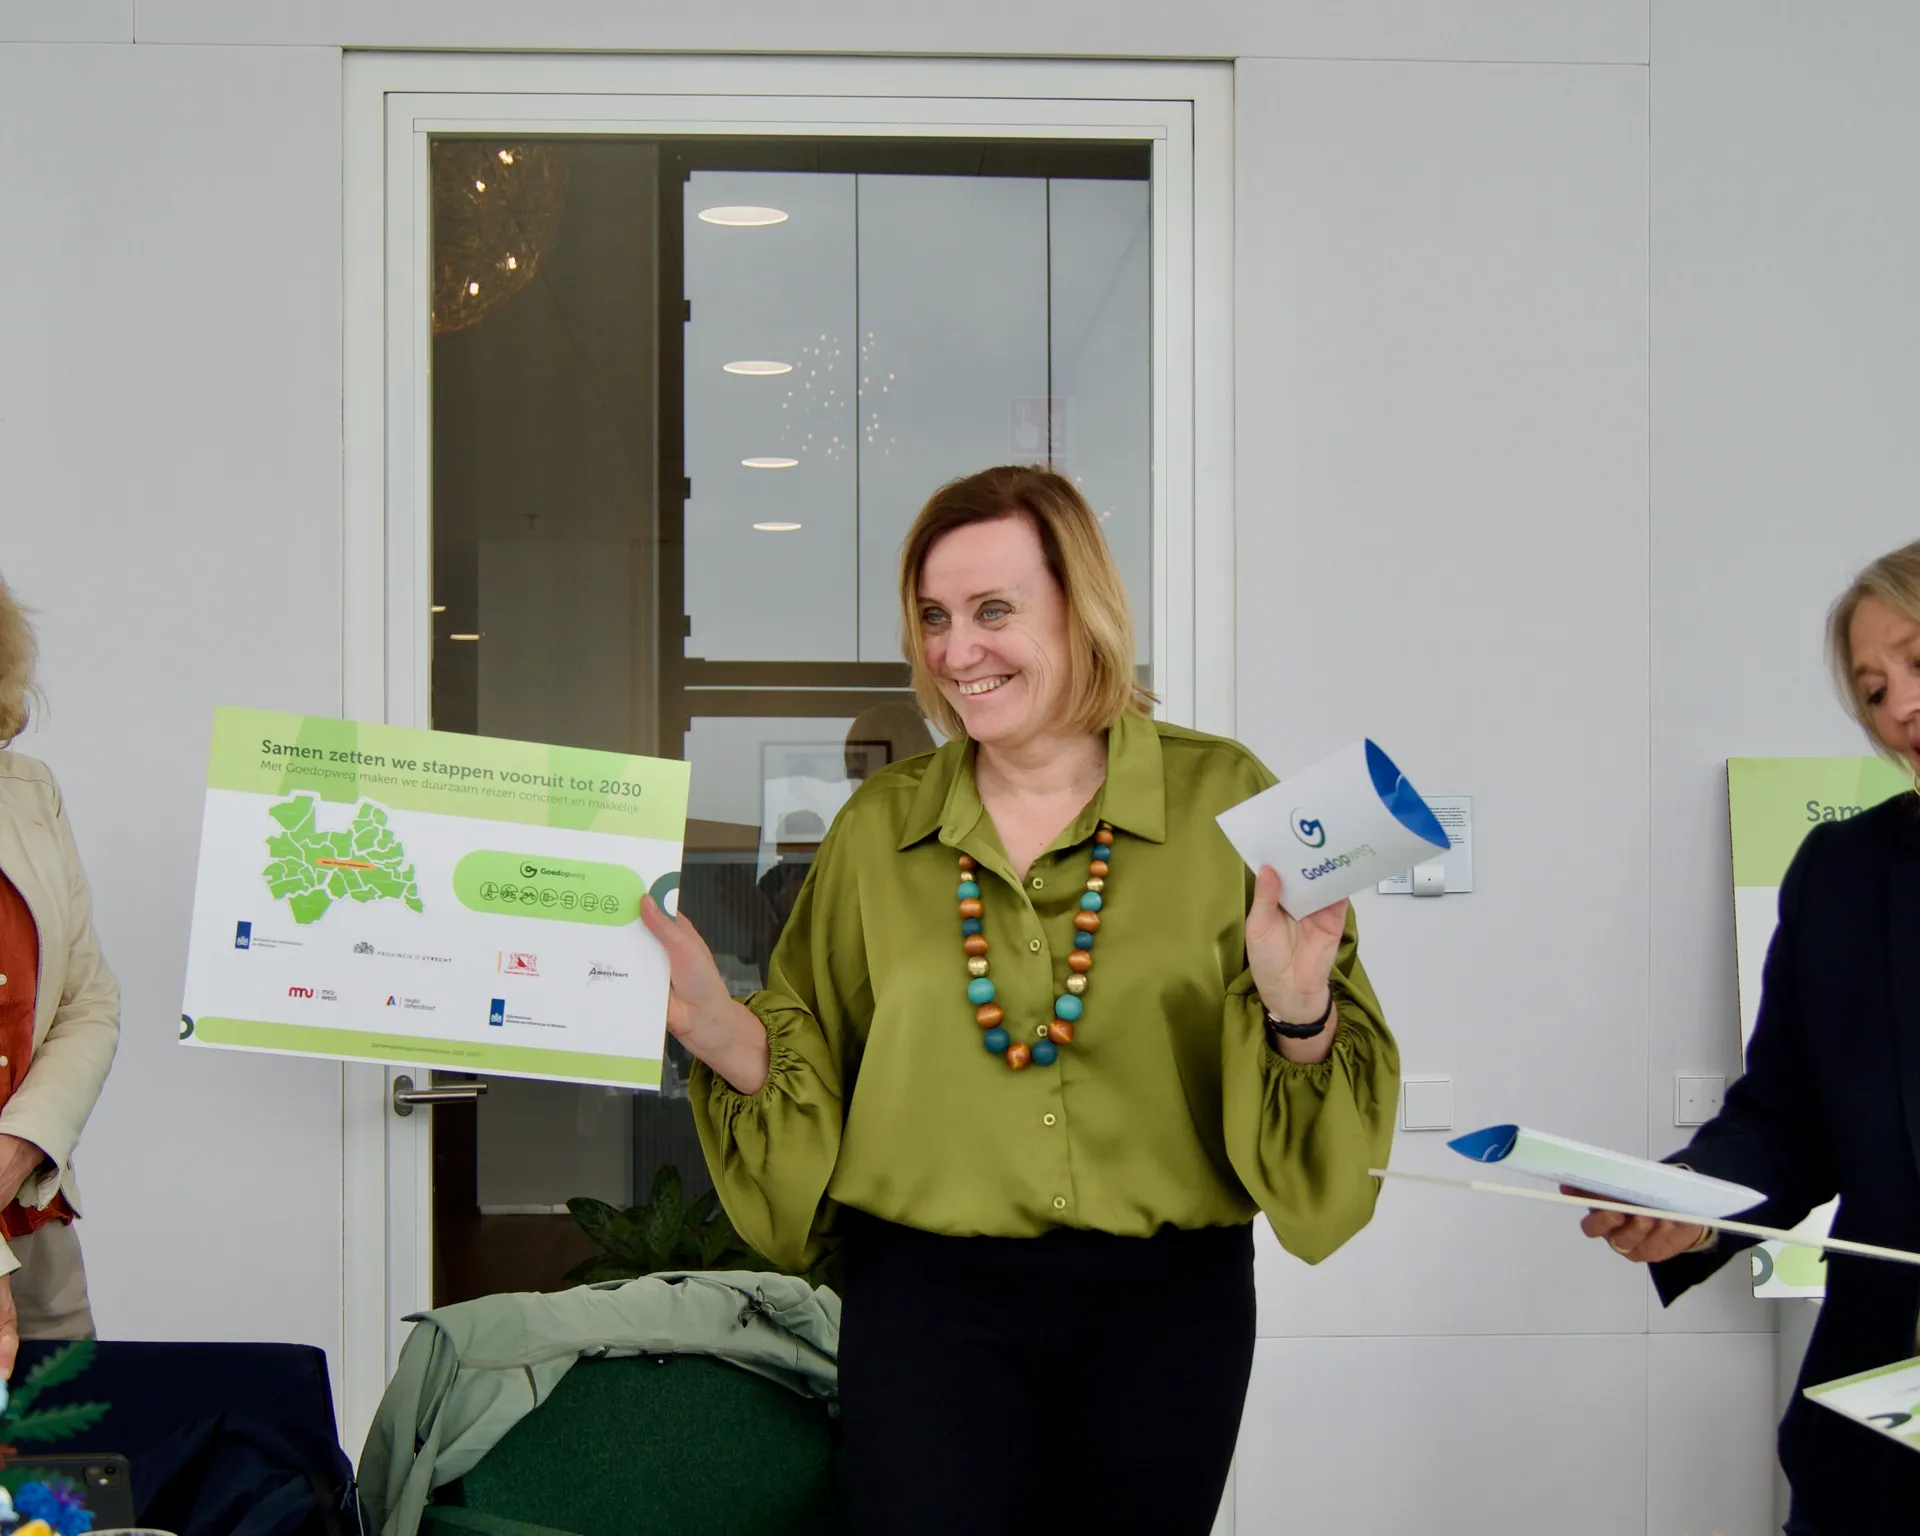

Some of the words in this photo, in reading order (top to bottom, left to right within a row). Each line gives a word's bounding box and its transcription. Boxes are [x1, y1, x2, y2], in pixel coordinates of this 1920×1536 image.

[261, 739, 323, 760] Samen
[329, 750, 386, 767] zetten
[391, 757, 417, 771] we
[422, 760, 494, 780] stappen
[500, 770, 564, 789] vooruit
[570, 776, 594, 791] tot
[599, 779, 642, 797] 2030
[260, 760, 282, 772] Met
[286, 762, 356, 781] Goedopweg
[359, 771, 398, 785] maken
[400, 777, 418, 787] we
[421, 779, 478, 794] duurzaam
[481, 786, 516, 799] reizen
[518, 791, 568, 806] concreet
[571, 797, 585, 807] en
[588, 799, 640, 814] makkelijk
[377, 951, 413, 960] PROVINCIE
[421, 955, 452, 963] UTRECHT
[588, 967, 629, 979] Amersfoort
